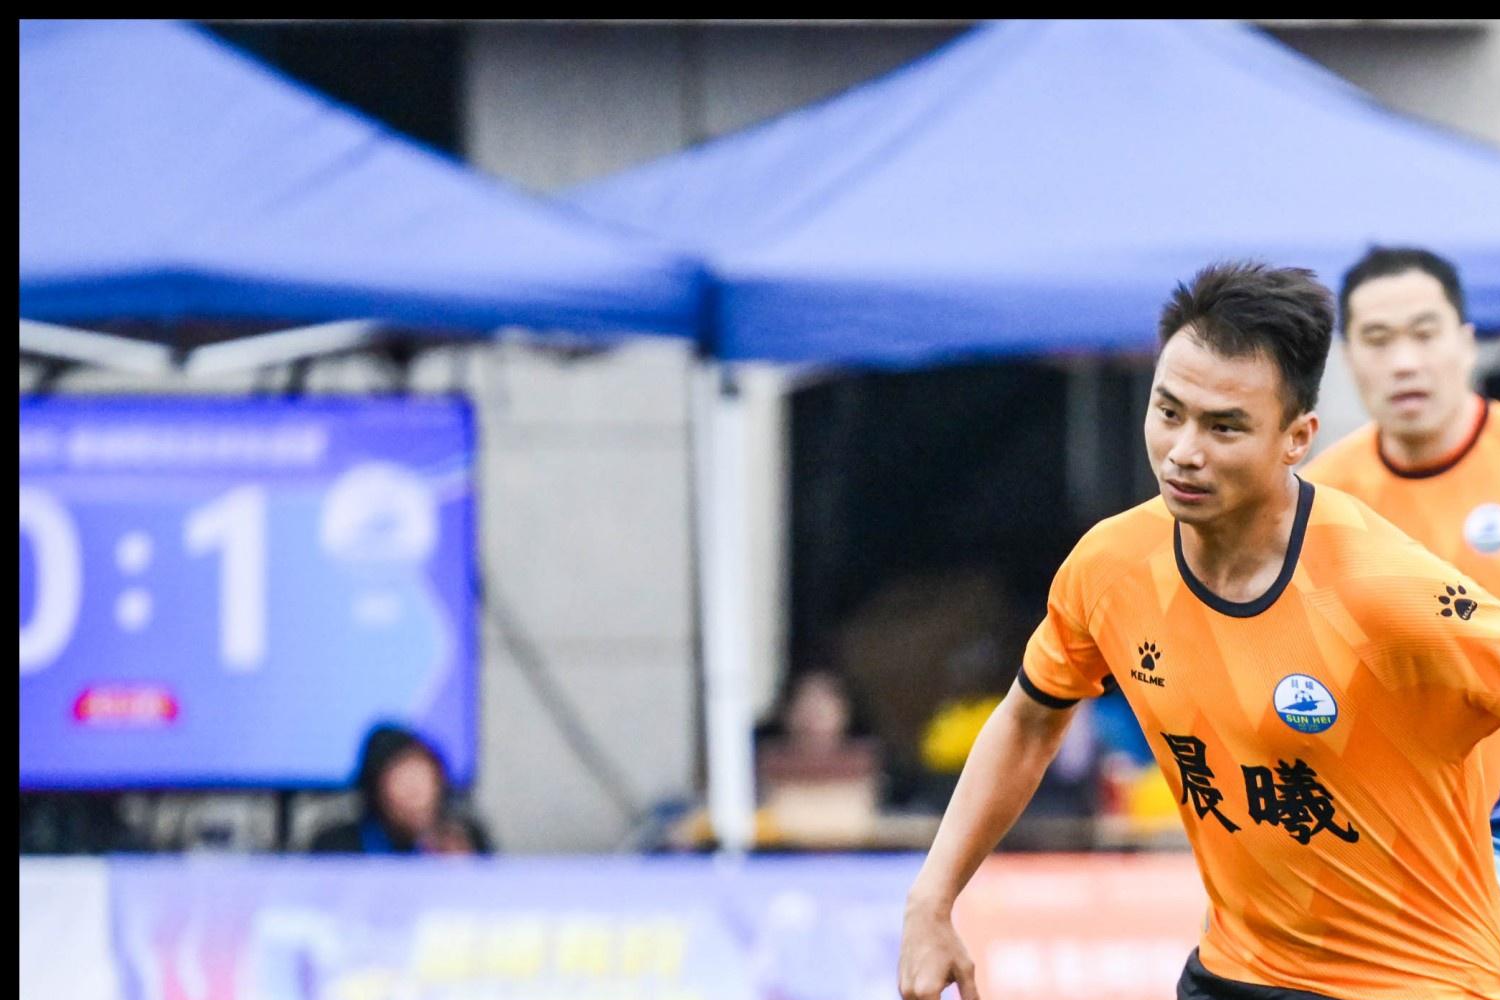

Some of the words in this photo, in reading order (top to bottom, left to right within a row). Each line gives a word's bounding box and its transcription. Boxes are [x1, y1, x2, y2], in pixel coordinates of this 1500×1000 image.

[1130, 669, 1165, 688] KELME
[1286, 714, 1309, 724] SUN
[1312, 716, 1331, 724] HEI
[1160, 731, 1360, 845] 晨曦
